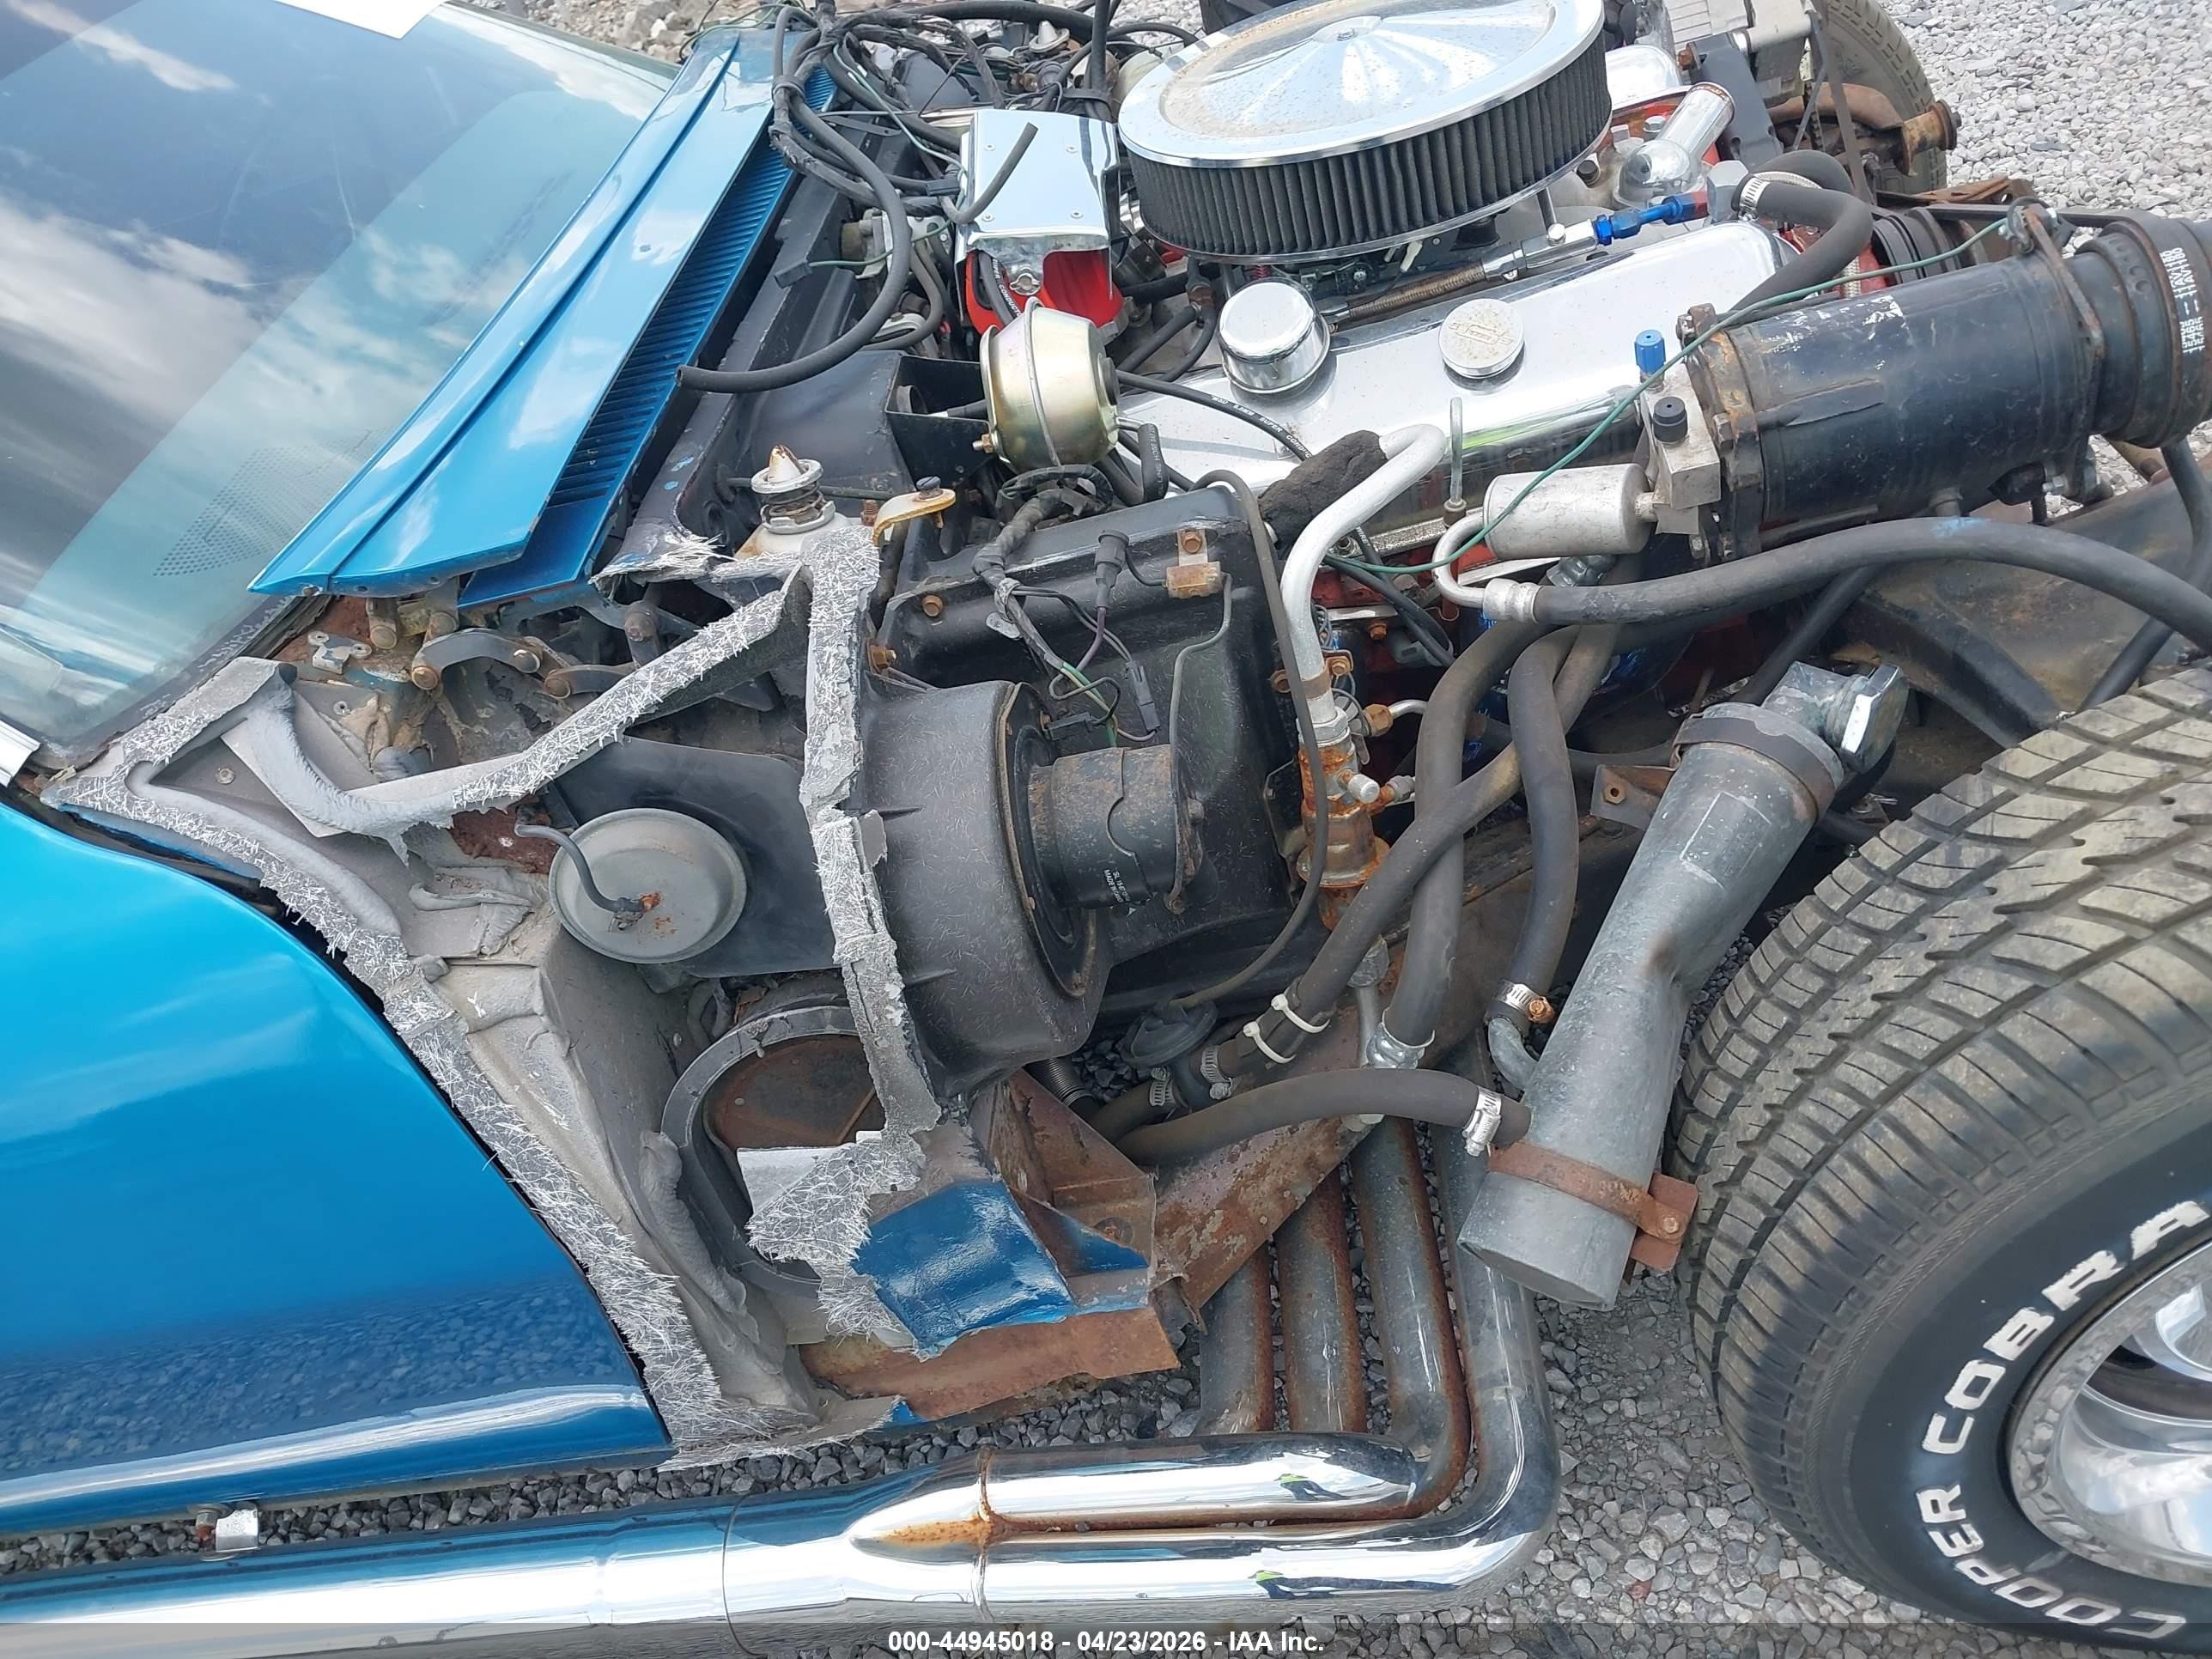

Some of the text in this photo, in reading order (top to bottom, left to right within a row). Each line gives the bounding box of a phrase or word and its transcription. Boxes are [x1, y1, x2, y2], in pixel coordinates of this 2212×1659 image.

[1259, 416, 1283, 433] SUPER
[1916, 1200, 2210, 1639] COOPER COBRA
